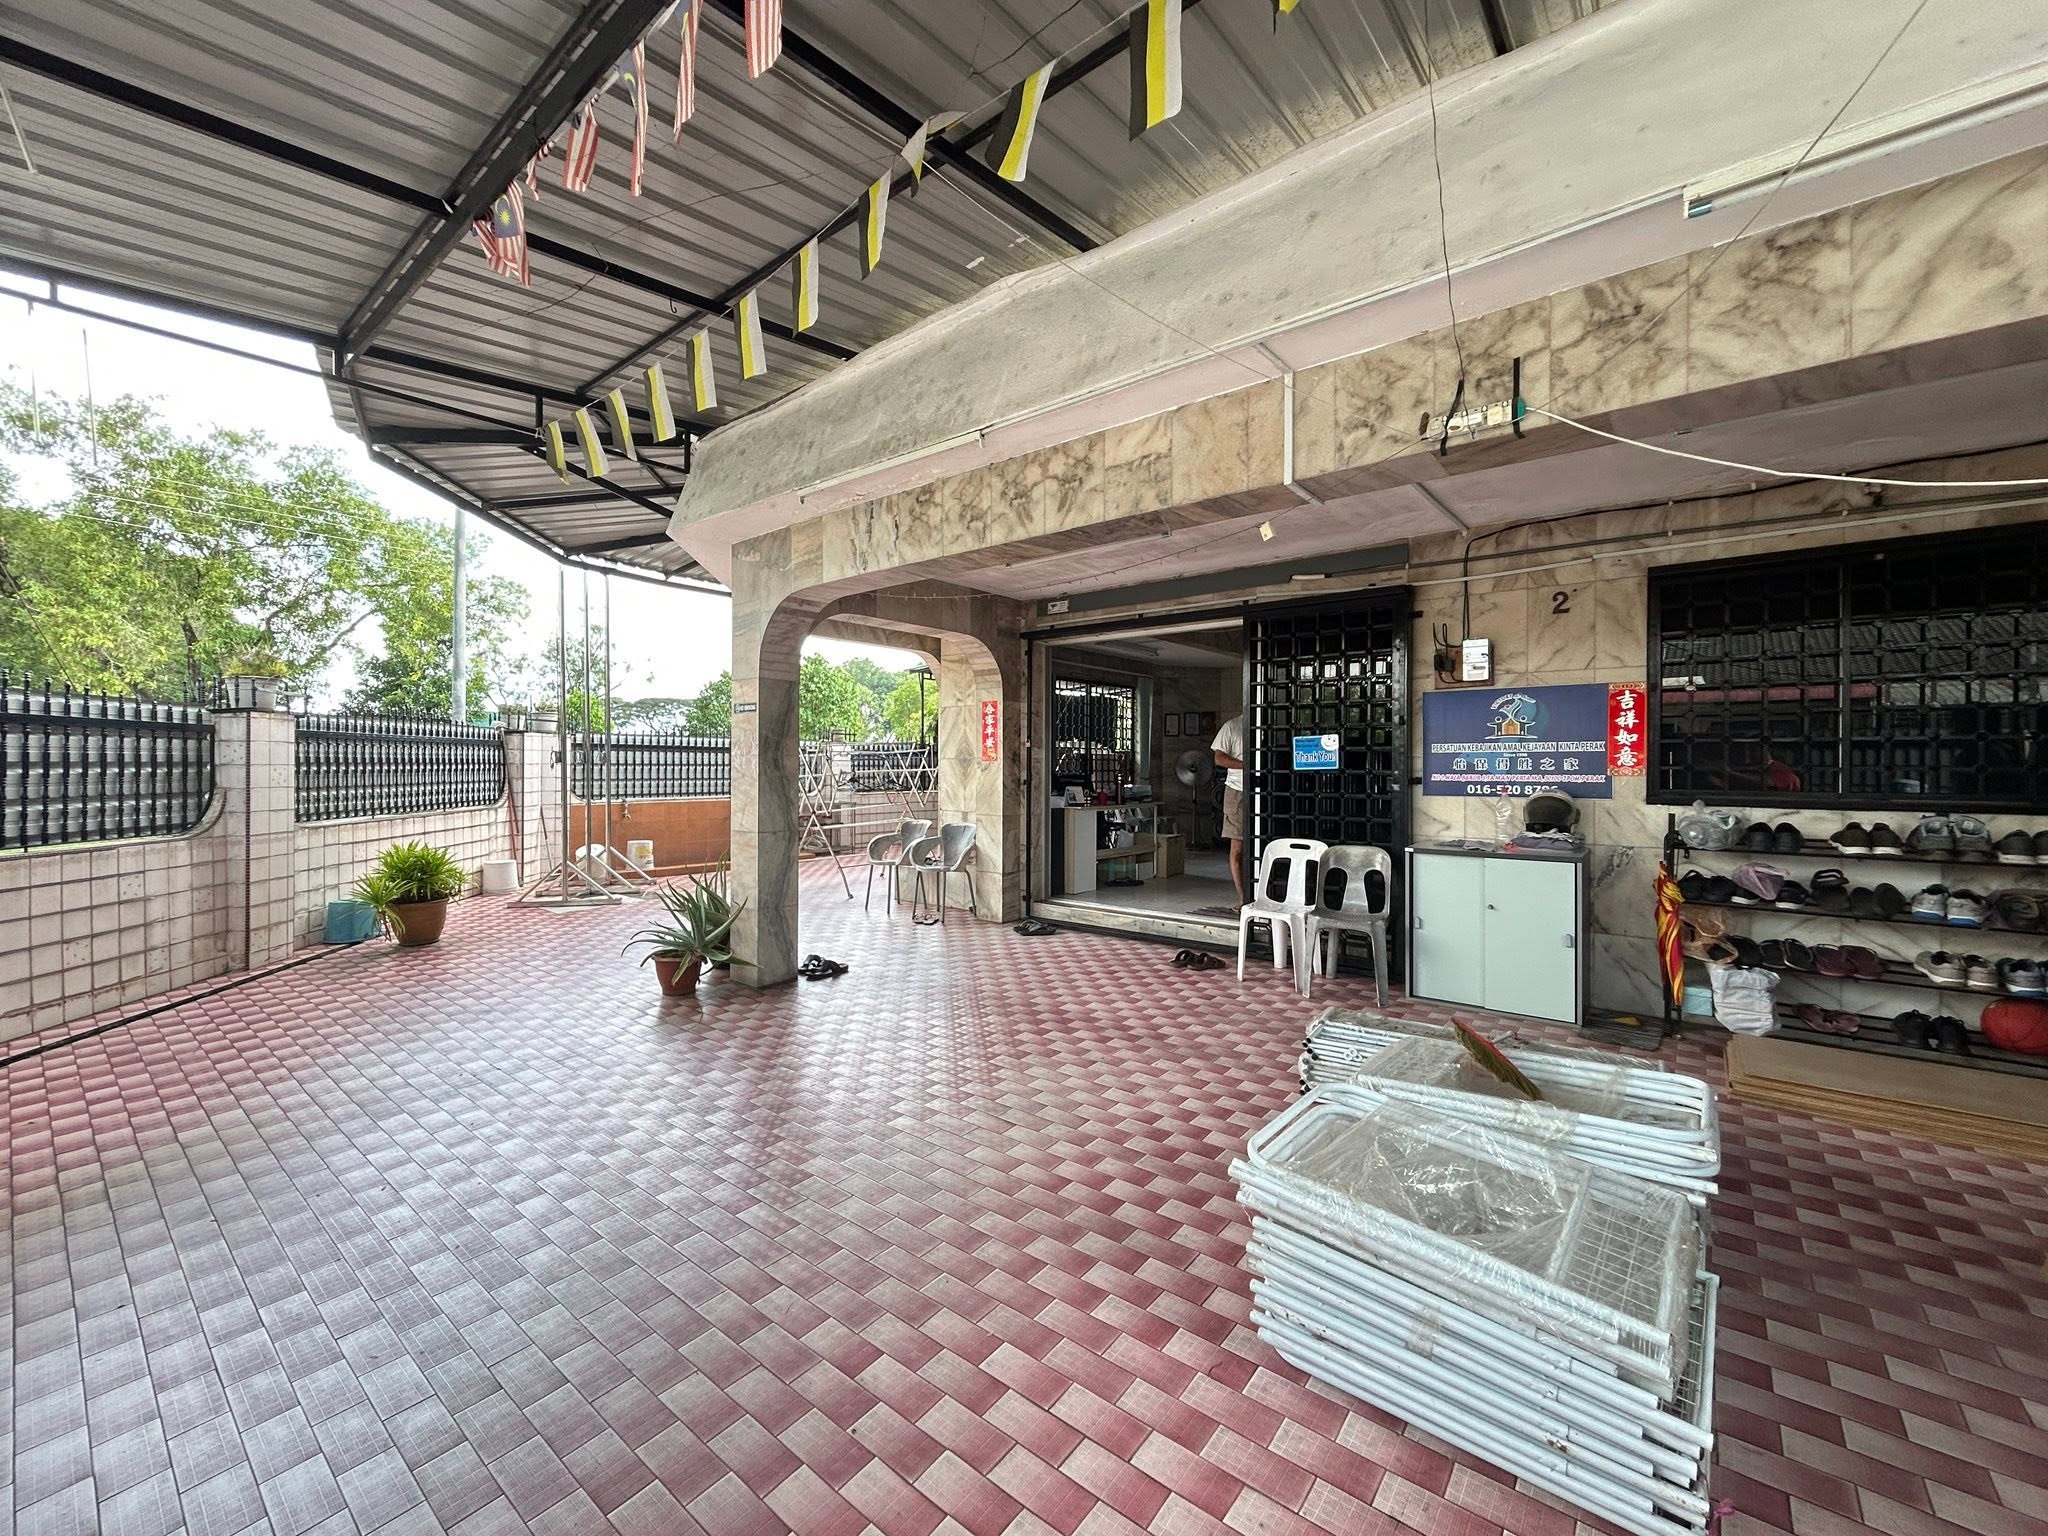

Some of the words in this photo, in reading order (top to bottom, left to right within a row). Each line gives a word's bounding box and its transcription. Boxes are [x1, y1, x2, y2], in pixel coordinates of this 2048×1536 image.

[1552, 591, 1570, 614] 2
[1614, 690, 1639, 766] 吉祥如意
[1432, 744, 1466, 753] PERSATUAN
[1467, 743, 1502, 752] KEBAJIKAN
[1503, 743, 1521, 752] AMAL
[1522, 742, 1556, 752] KEJAYAAN
[1558, 742, 1579, 751] KINTA
[1580, 741, 1605, 751] PERAK
[1295, 751, 1318, 762] Thank
[1467, 785, 1520, 795] 016-520
